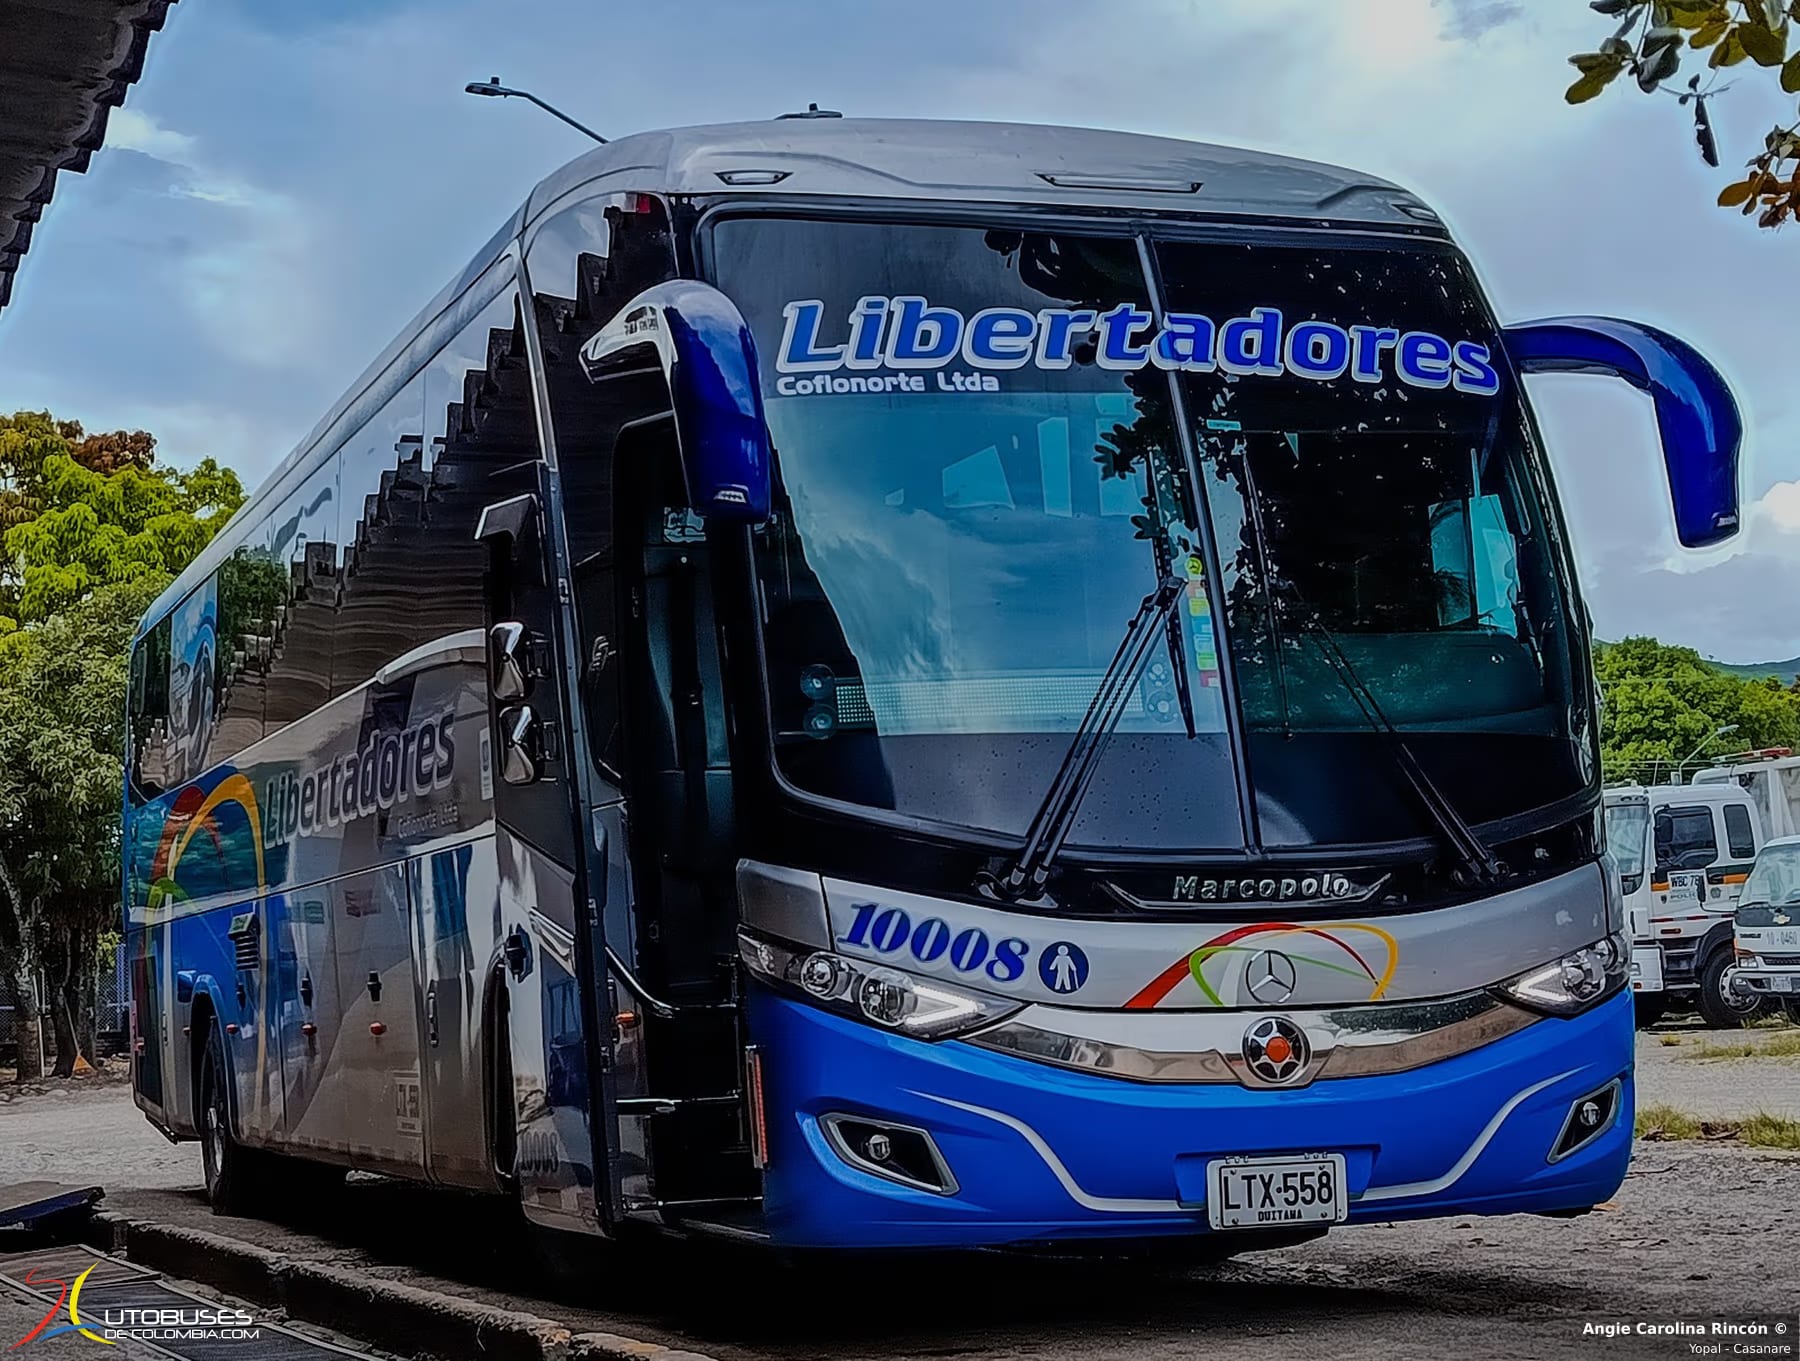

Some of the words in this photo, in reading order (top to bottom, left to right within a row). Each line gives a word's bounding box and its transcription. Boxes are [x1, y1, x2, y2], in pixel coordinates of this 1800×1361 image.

[774, 295, 1501, 395] Libertadores
[776, 373, 925, 395] Coflonorte
[937, 372, 999, 391] Ltda
[263, 711, 455, 850] Libertadores
[1172, 873, 1350, 899] Marcopolo
[836, 902, 1030, 983] 10008
